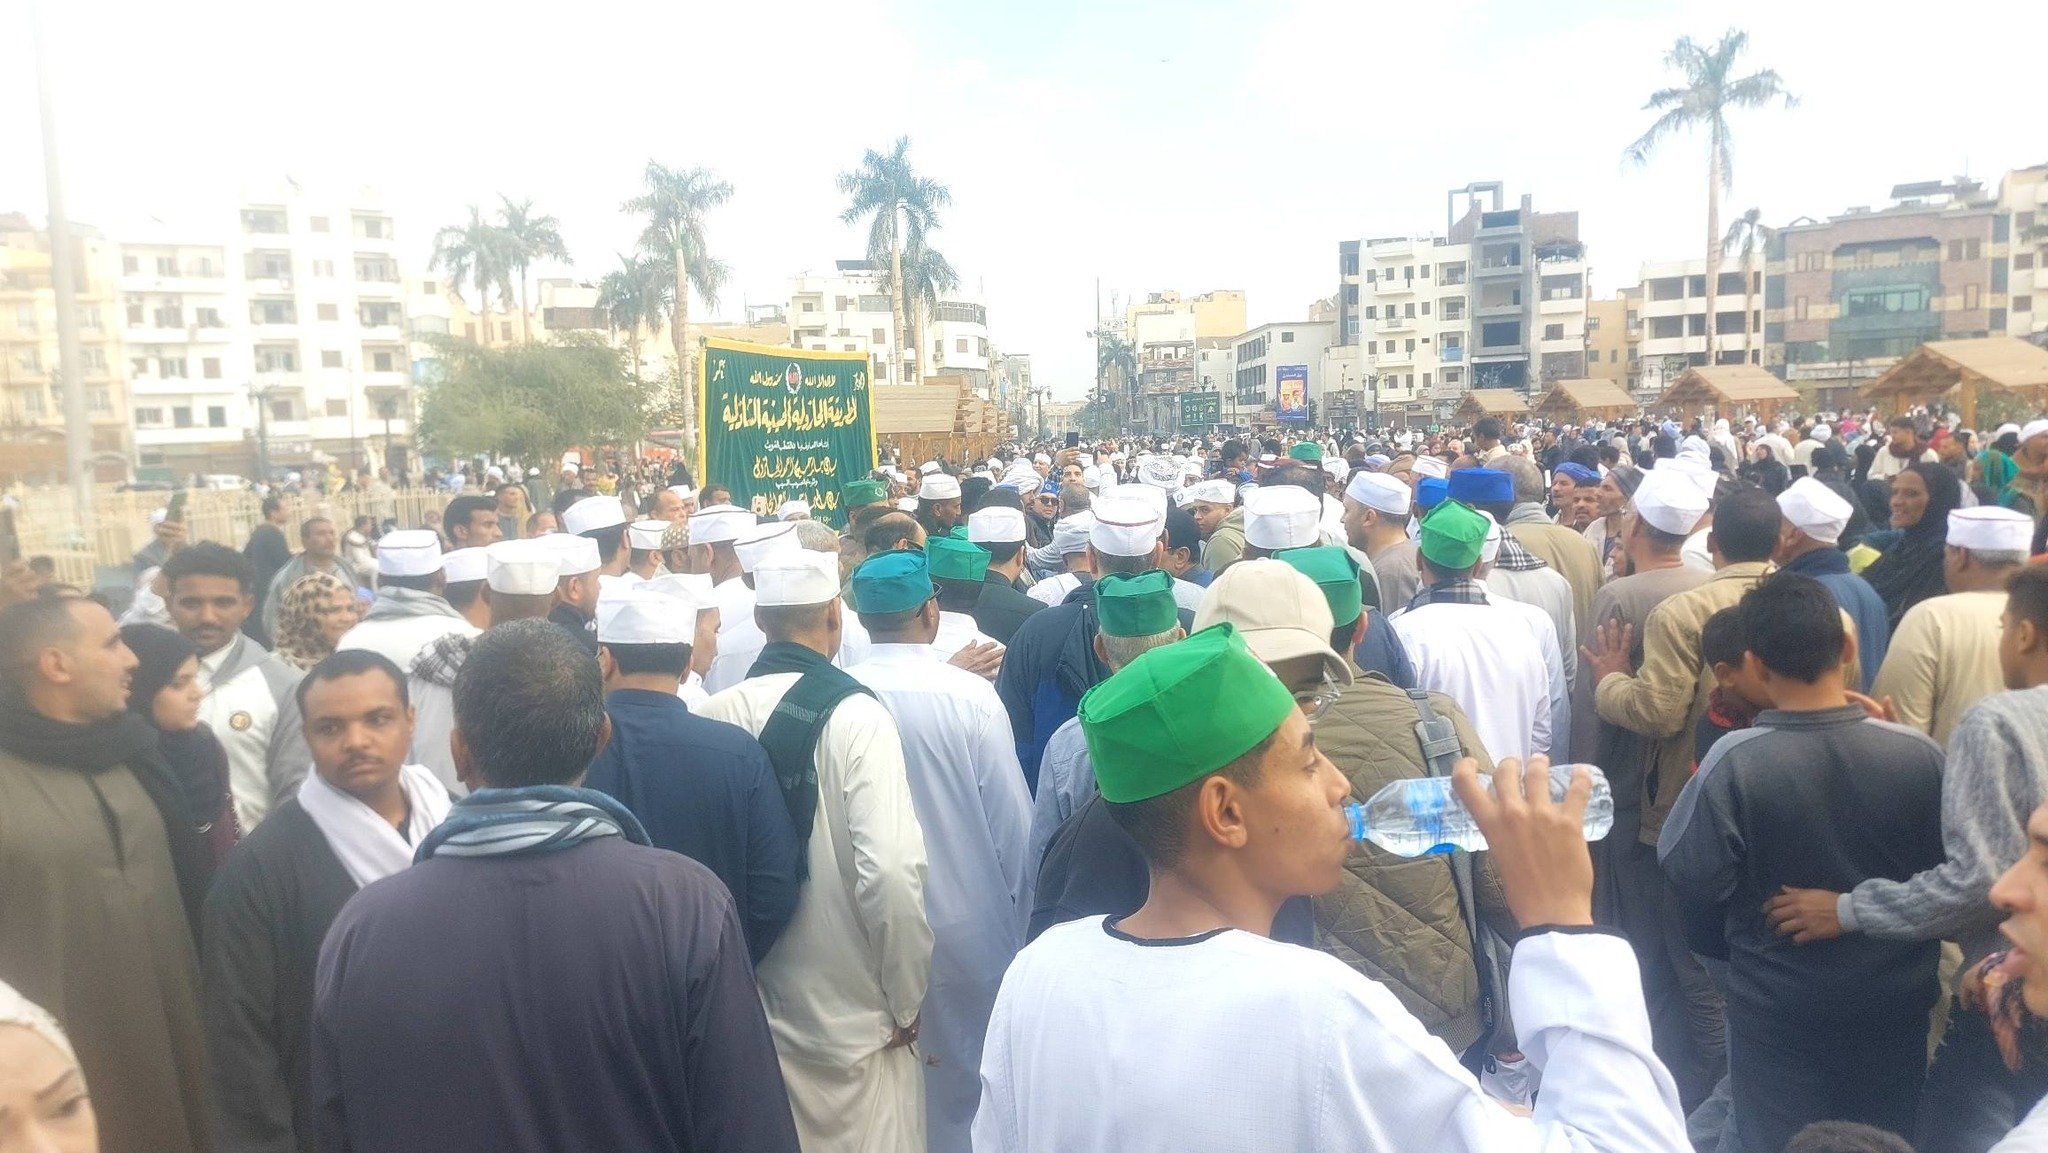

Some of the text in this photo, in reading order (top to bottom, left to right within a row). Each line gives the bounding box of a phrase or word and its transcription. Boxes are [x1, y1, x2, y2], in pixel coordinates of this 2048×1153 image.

[722, 393, 762, 431] الشاذلية
[792, 395, 827, 432] الجازولية
[826, 395, 858, 428] الطريقة
